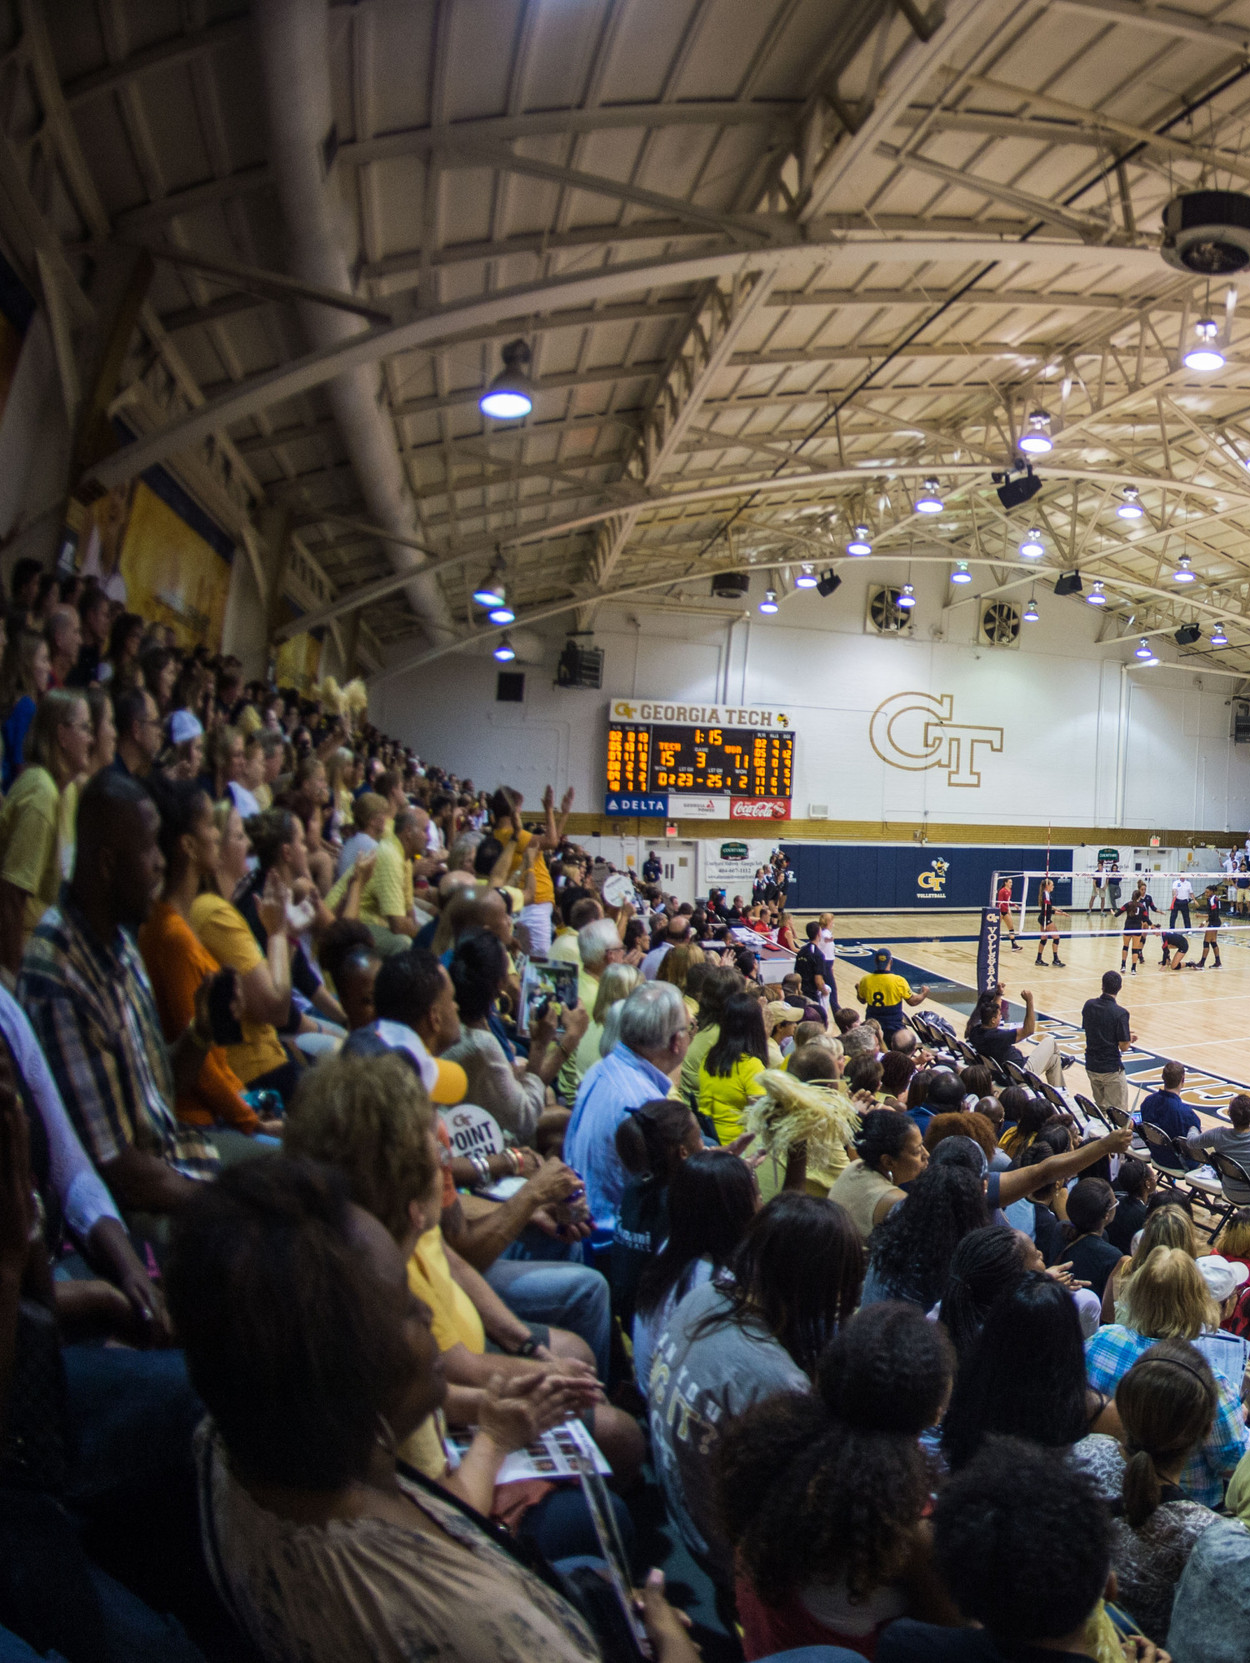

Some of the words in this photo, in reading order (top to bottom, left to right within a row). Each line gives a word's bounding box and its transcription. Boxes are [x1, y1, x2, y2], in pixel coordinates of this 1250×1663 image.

[614, 702, 637, 719] GT
[640, 704, 721, 724] GEORGIA
[725, 709, 772, 727] TECH
[658, 742, 681, 751] TECH
[754, 738, 767, 748] 02
[869, 691, 1004, 788] GT
[661, 751, 675, 767] 15
[696, 751, 707, 768] 3
[754, 748, 767, 758] 05
[735, 754, 749, 769] 11
[658, 772, 668, 787] 0
[677, 773, 694, 787] 23
[706, 774, 723, 788] 25
[739, 775, 748, 789] 2
[622, 800, 664, 811] DELTA
[917, 871, 946, 891] GT
[986, 913, 999, 923] GT
[872, 992, 884, 1007] 8
[453, 1113, 472, 1127] GT
